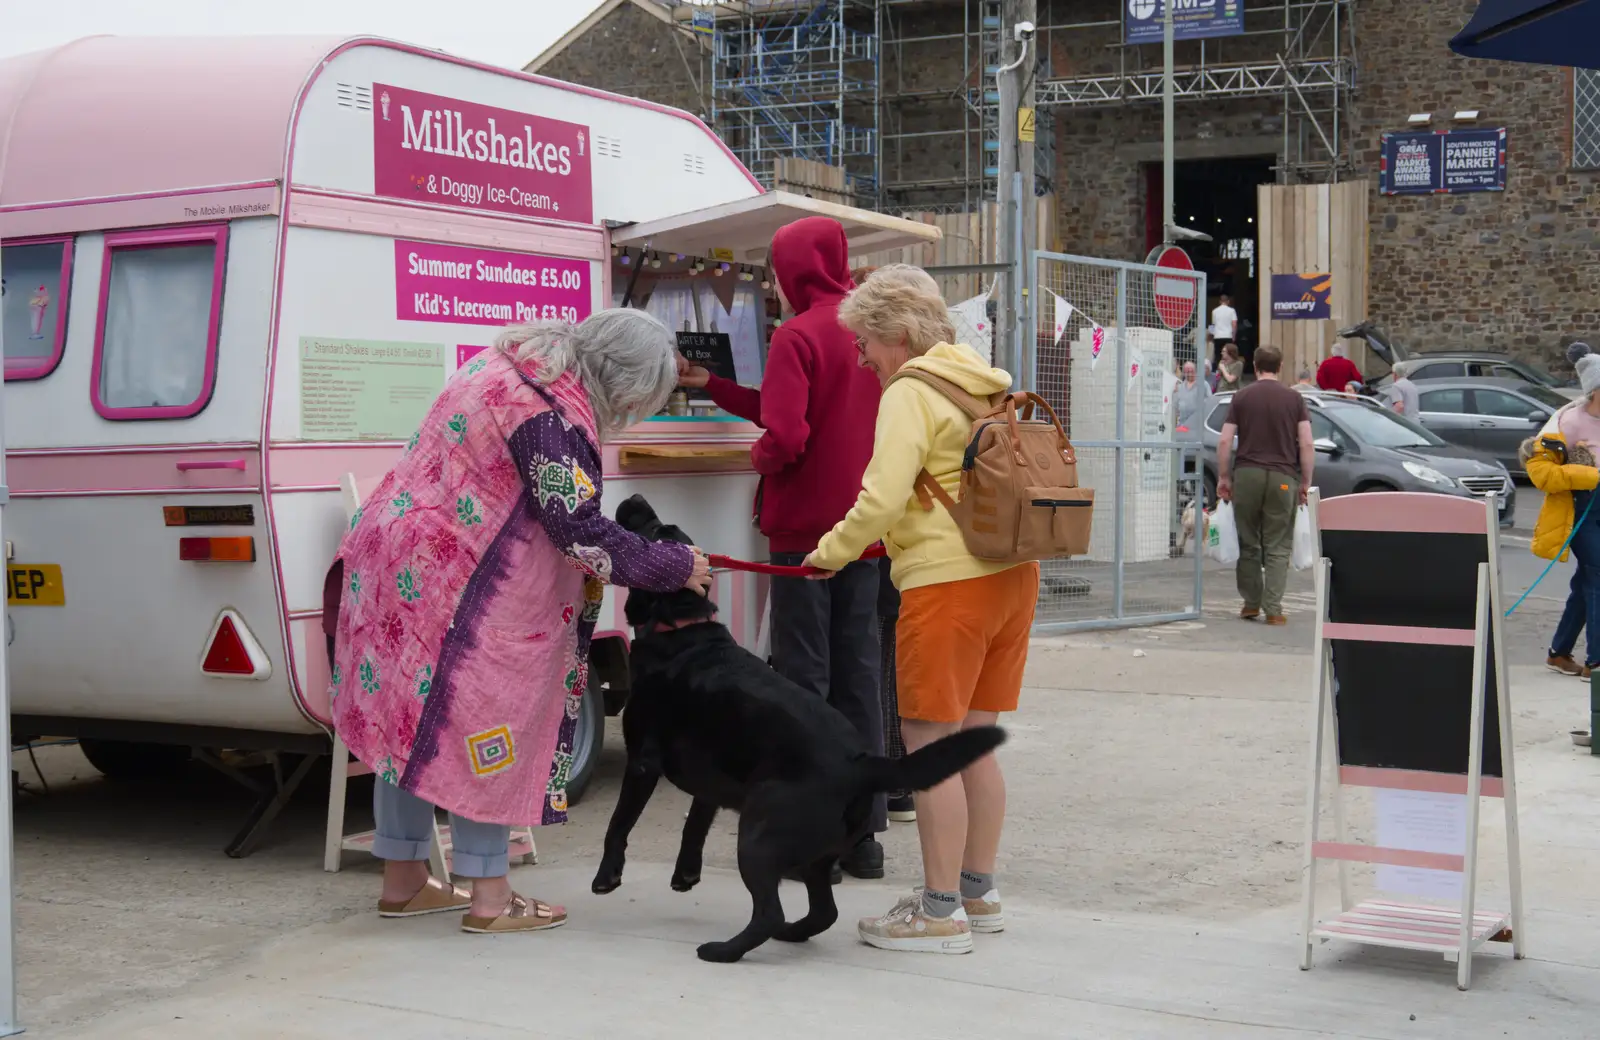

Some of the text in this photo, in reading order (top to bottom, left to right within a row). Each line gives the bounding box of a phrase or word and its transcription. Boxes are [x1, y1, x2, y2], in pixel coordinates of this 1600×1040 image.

[401, 105, 571, 176] Milkshakes
[1399, 144, 1428, 153] GREAT
[1446, 147, 1496, 159] PANNIER
[1395, 159, 1430, 167] MARKET
[1446, 158, 1496, 169] MARKET
[1395, 166, 1431, 174] AWARDS
[1394, 173, 1431, 182] WINNER
[1479, 175, 1495, 184] 1pm
[427, 174, 551, 210] & Doggy Ice-Cream
[184, 203, 271, 217] The Mobile Milkshaker
[408, 252, 581, 291] Summer Sundaes £5.00
[414, 292, 450, 316] Kid's
[453, 296, 512, 320] Icecream
[516, 301, 538, 321] Pot
[1274, 301, 1316, 312] mercury
[678, 335, 717, 346] WATER IN
[686, 350, 693, 359] A
[961, 871, 982, 883] idas
[927, 891, 956, 903] adidas
